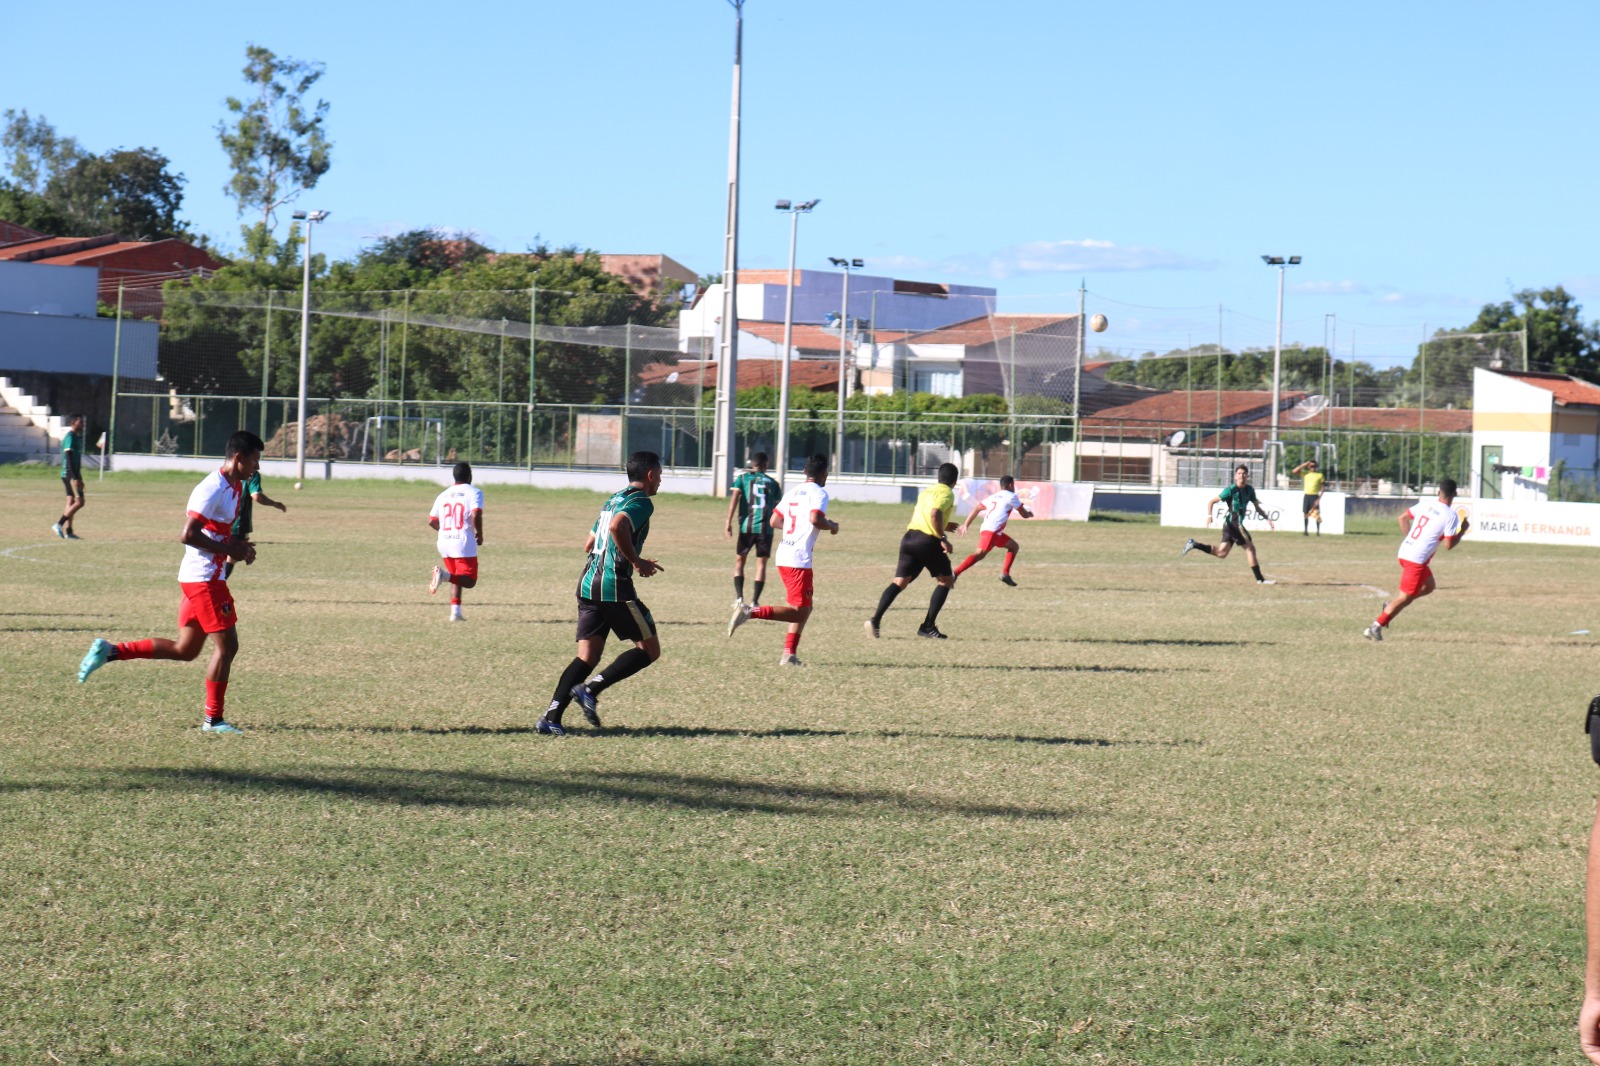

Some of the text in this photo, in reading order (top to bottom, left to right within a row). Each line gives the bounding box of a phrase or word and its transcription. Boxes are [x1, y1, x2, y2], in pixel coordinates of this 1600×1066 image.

[751, 483, 767, 509] 5
[443, 502, 465, 531] 20
[786, 502, 799, 535] 5
[986, 501, 997, 519] 7
[1216, 508, 1280, 522] FRICIO
[1411, 515, 1430, 540] 8
[1480, 521, 1592, 537] MARIA FERNANDA
